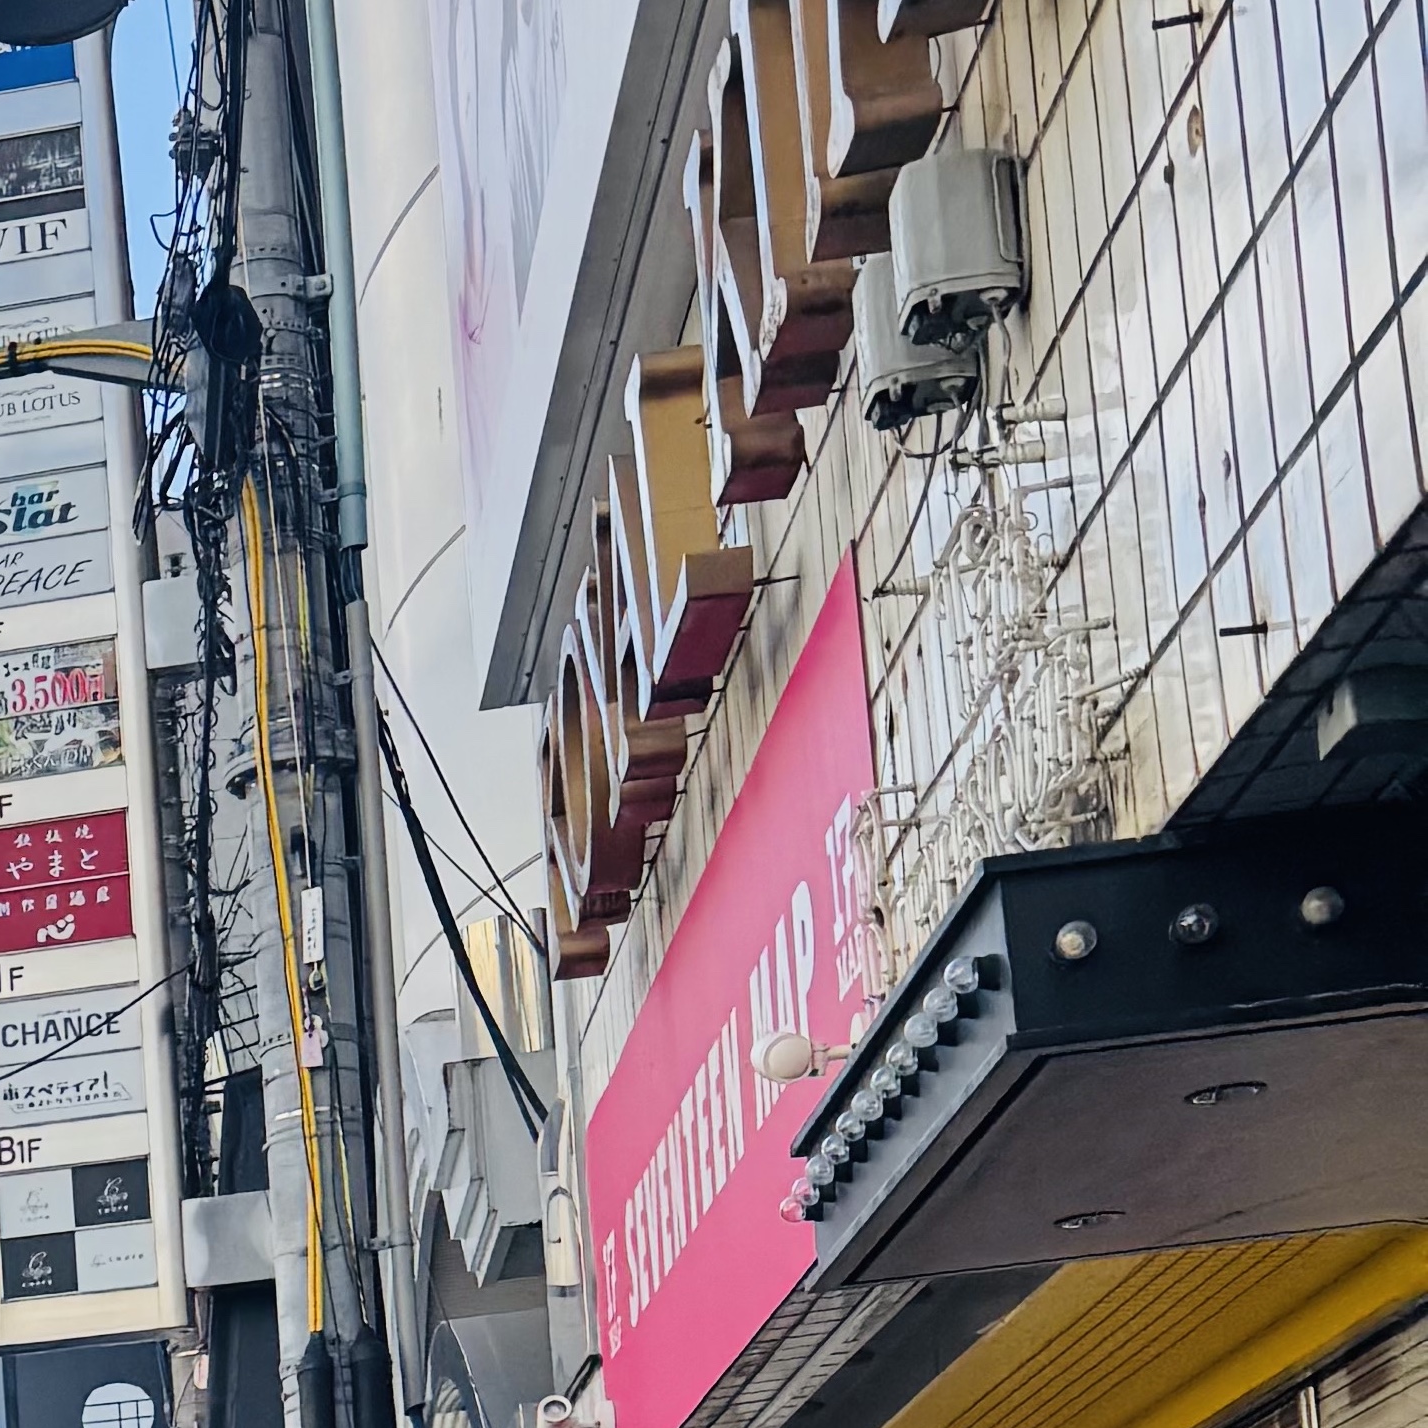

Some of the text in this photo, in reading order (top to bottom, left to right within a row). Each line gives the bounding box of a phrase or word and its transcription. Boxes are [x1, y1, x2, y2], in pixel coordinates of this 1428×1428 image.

[22, 391, 81, 413] LOTUS
[6, 848, 98, 880] やまと
[1, 1011, 121, 1048] CHANCE
[624, 1006, 745, 1329] SEVENTEEN
[749, 880, 815, 1131] MAP
